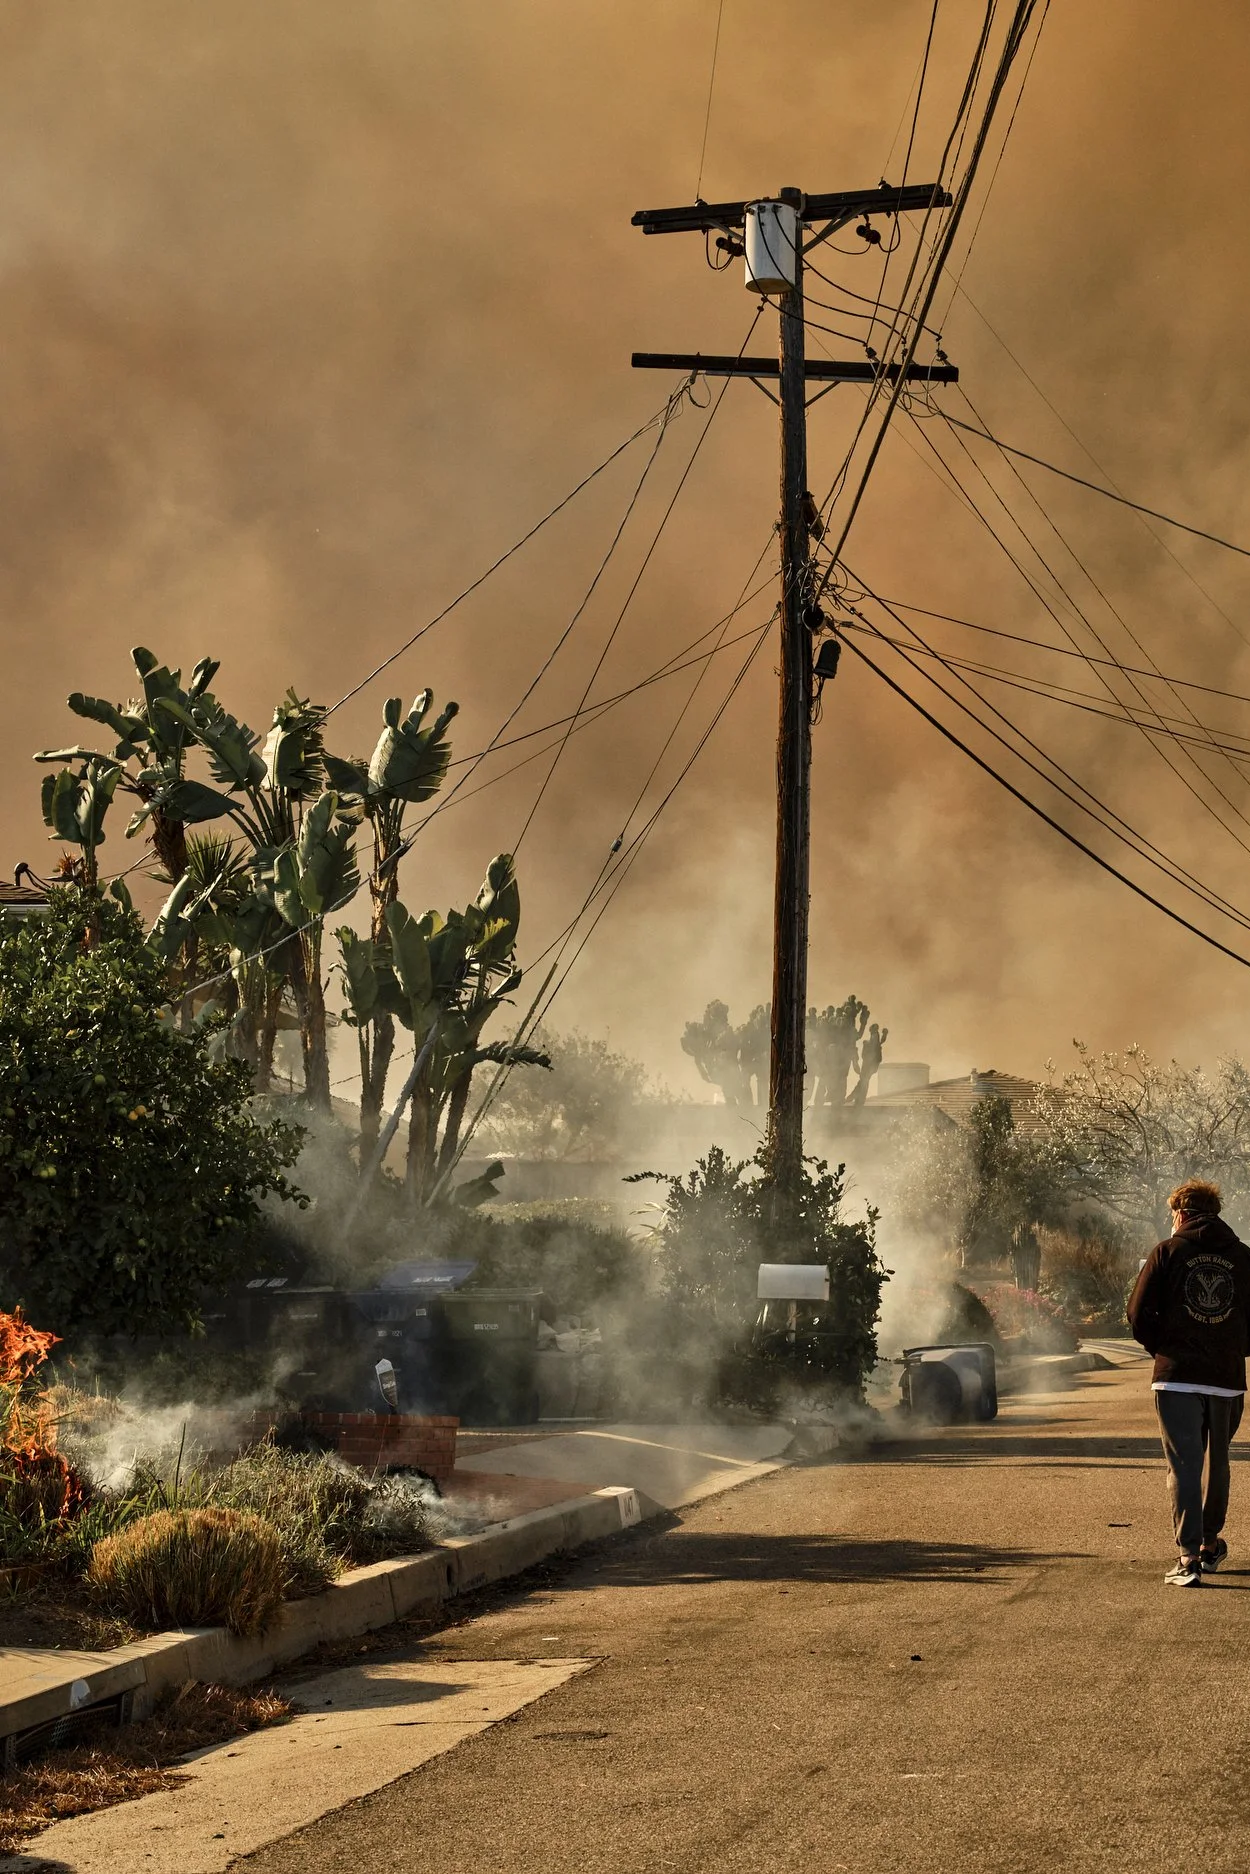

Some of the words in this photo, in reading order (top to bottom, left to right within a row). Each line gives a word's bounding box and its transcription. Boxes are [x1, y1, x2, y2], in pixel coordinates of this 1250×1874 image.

[1186, 1256, 1211, 1268] DUTTON
[1213, 1256, 1234, 1270] RANCH
[1194, 1313, 1208, 1323] EST.
